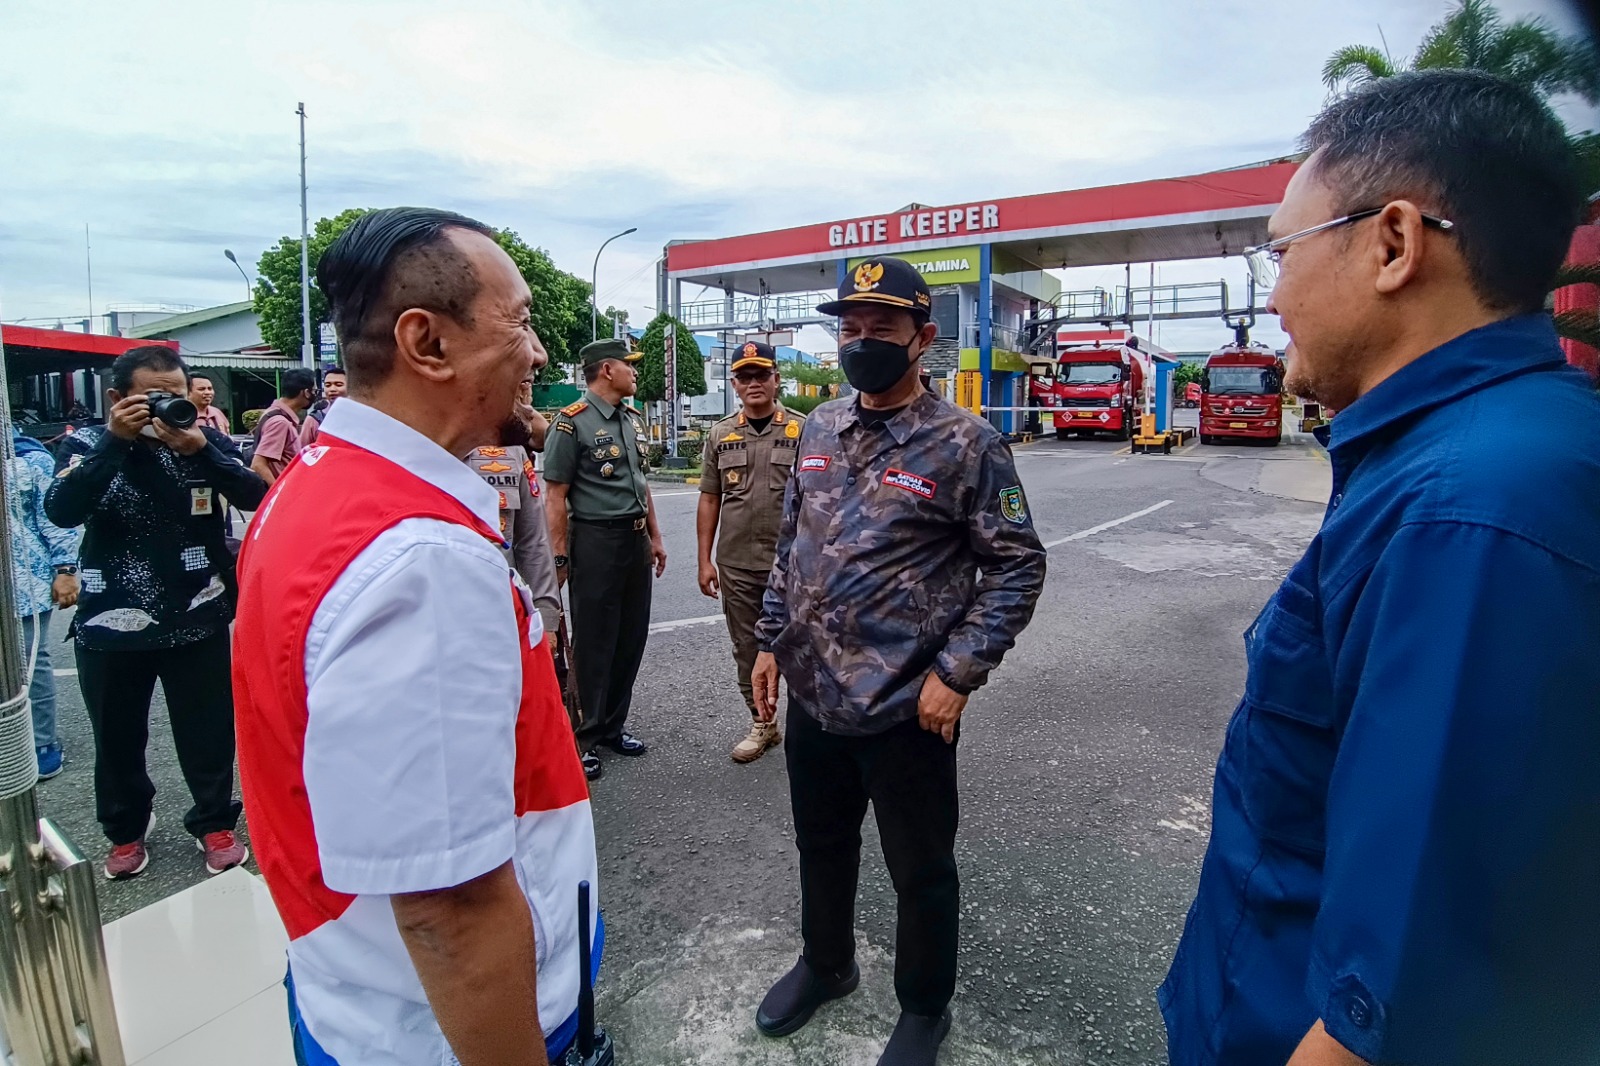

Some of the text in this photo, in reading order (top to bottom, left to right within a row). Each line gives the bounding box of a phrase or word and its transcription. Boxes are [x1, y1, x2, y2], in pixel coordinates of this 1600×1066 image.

[829, 204, 999, 247] GATE KEEPER
[911, 258, 970, 273] TAMINA
